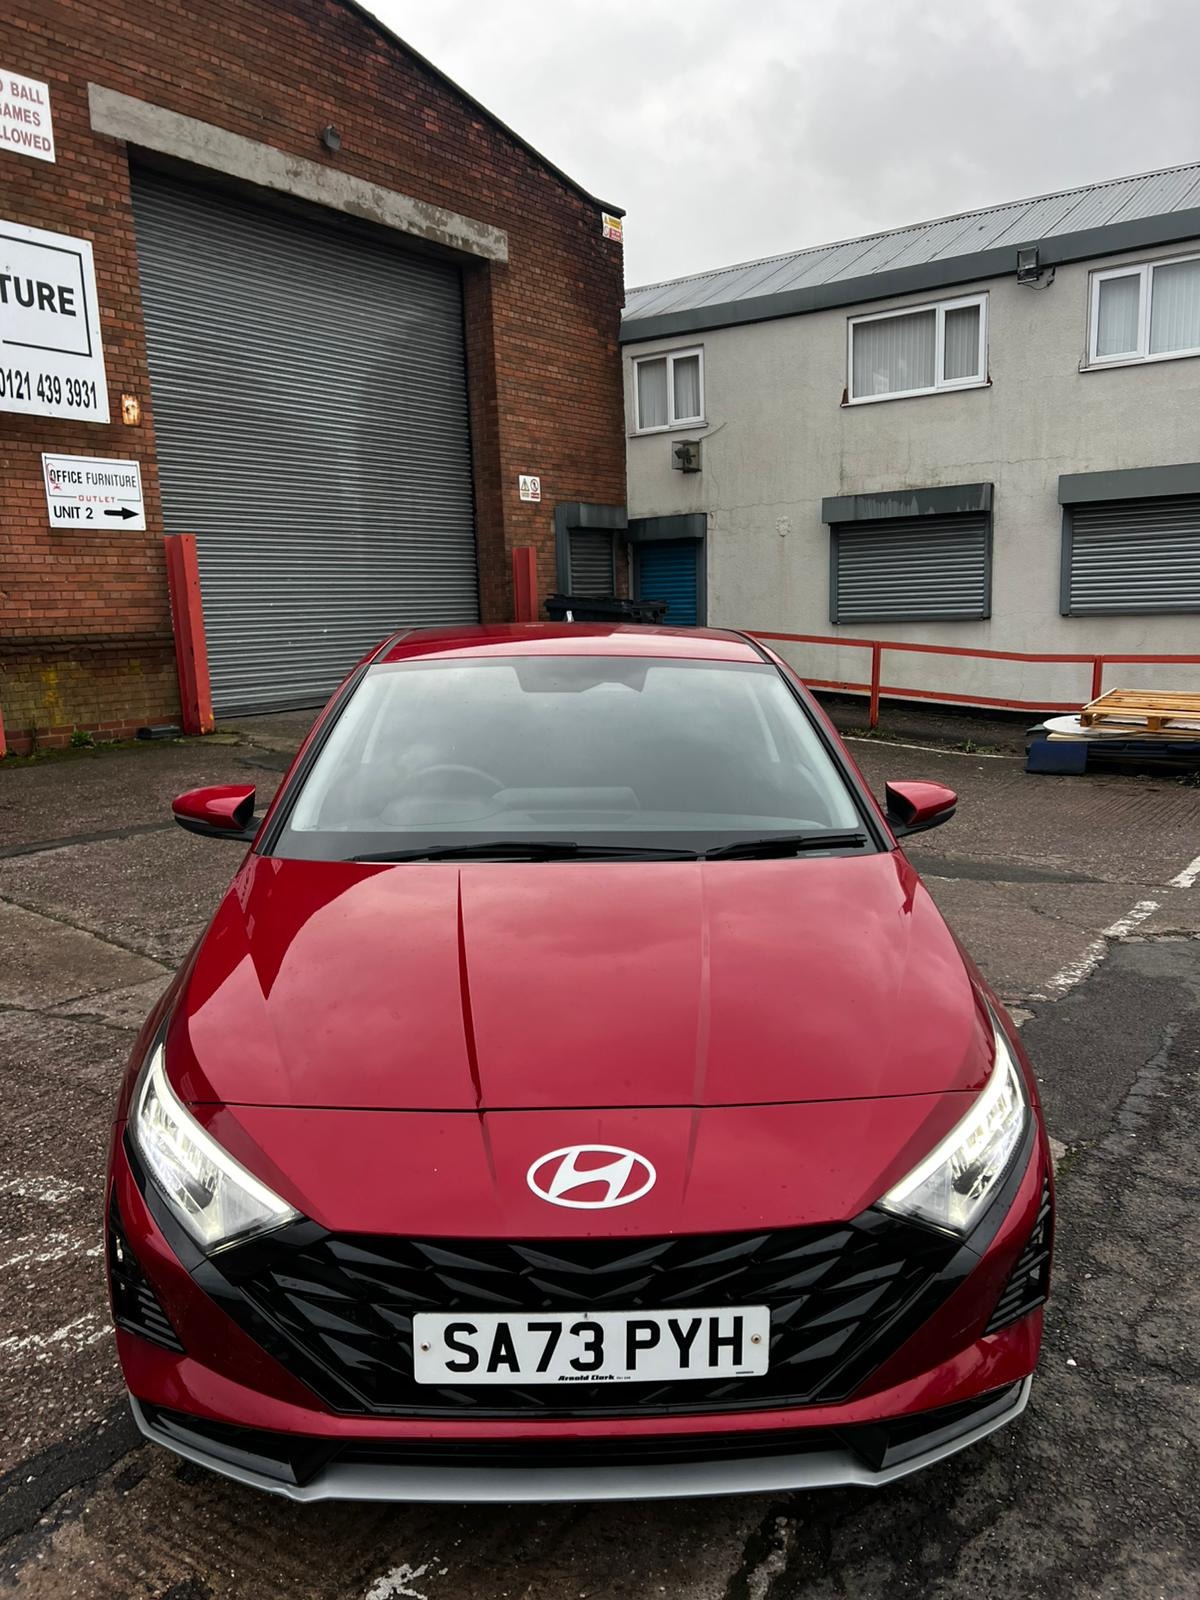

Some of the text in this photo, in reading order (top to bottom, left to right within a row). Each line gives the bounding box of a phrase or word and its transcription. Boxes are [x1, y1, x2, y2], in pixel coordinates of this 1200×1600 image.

[10, 81, 44, 104] BALL
[0, 102, 42, 127] AMES
[0, 273, 77, 317] TURE
[37, 373, 62, 404] 439
[66, 376, 97, 409] 3931
[49, 469, 137, 488] OFFICE FURNITURE
[78, 495, 116, 503] OUTLET
[53, 505, 94, 519] UNIT 2
[444, 1315, 744, 1373] SA73 PYH
